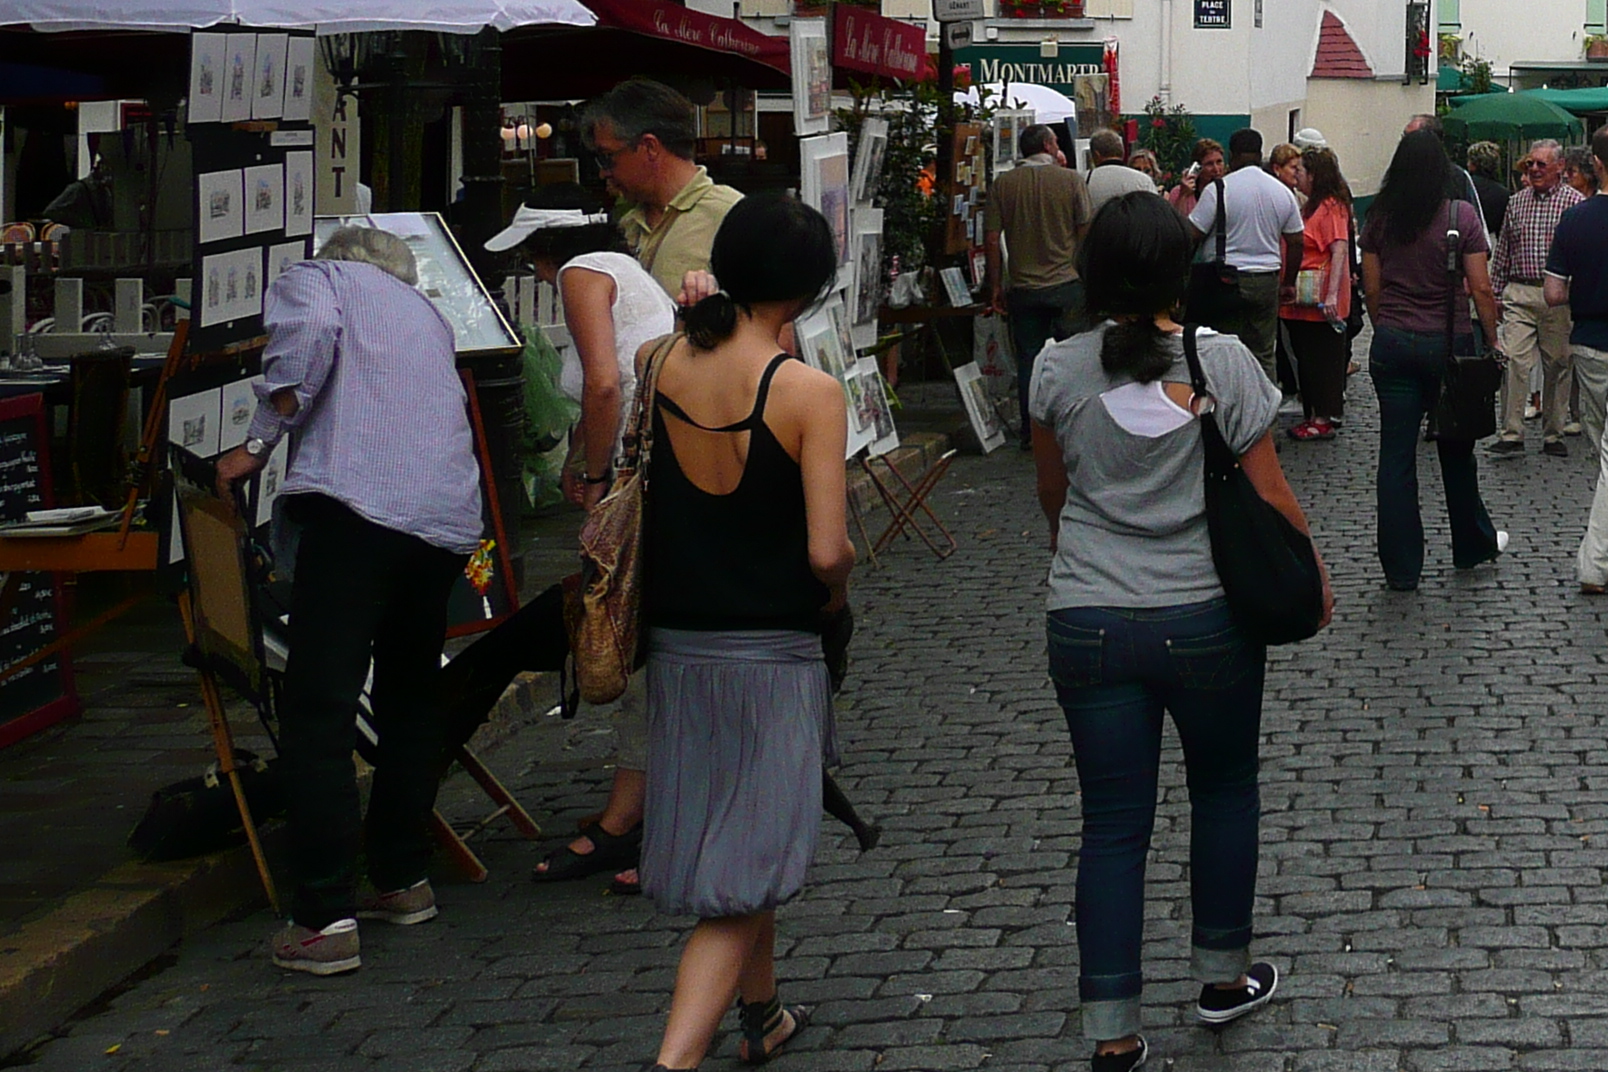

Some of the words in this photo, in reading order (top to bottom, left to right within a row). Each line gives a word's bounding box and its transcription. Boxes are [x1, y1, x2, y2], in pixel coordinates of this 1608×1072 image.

[1201, 0, 1224, 9] PLACE
[1199, 15, 1225, 24] TERTRE
[980, 59, 1100, 83] MONTMARTR
